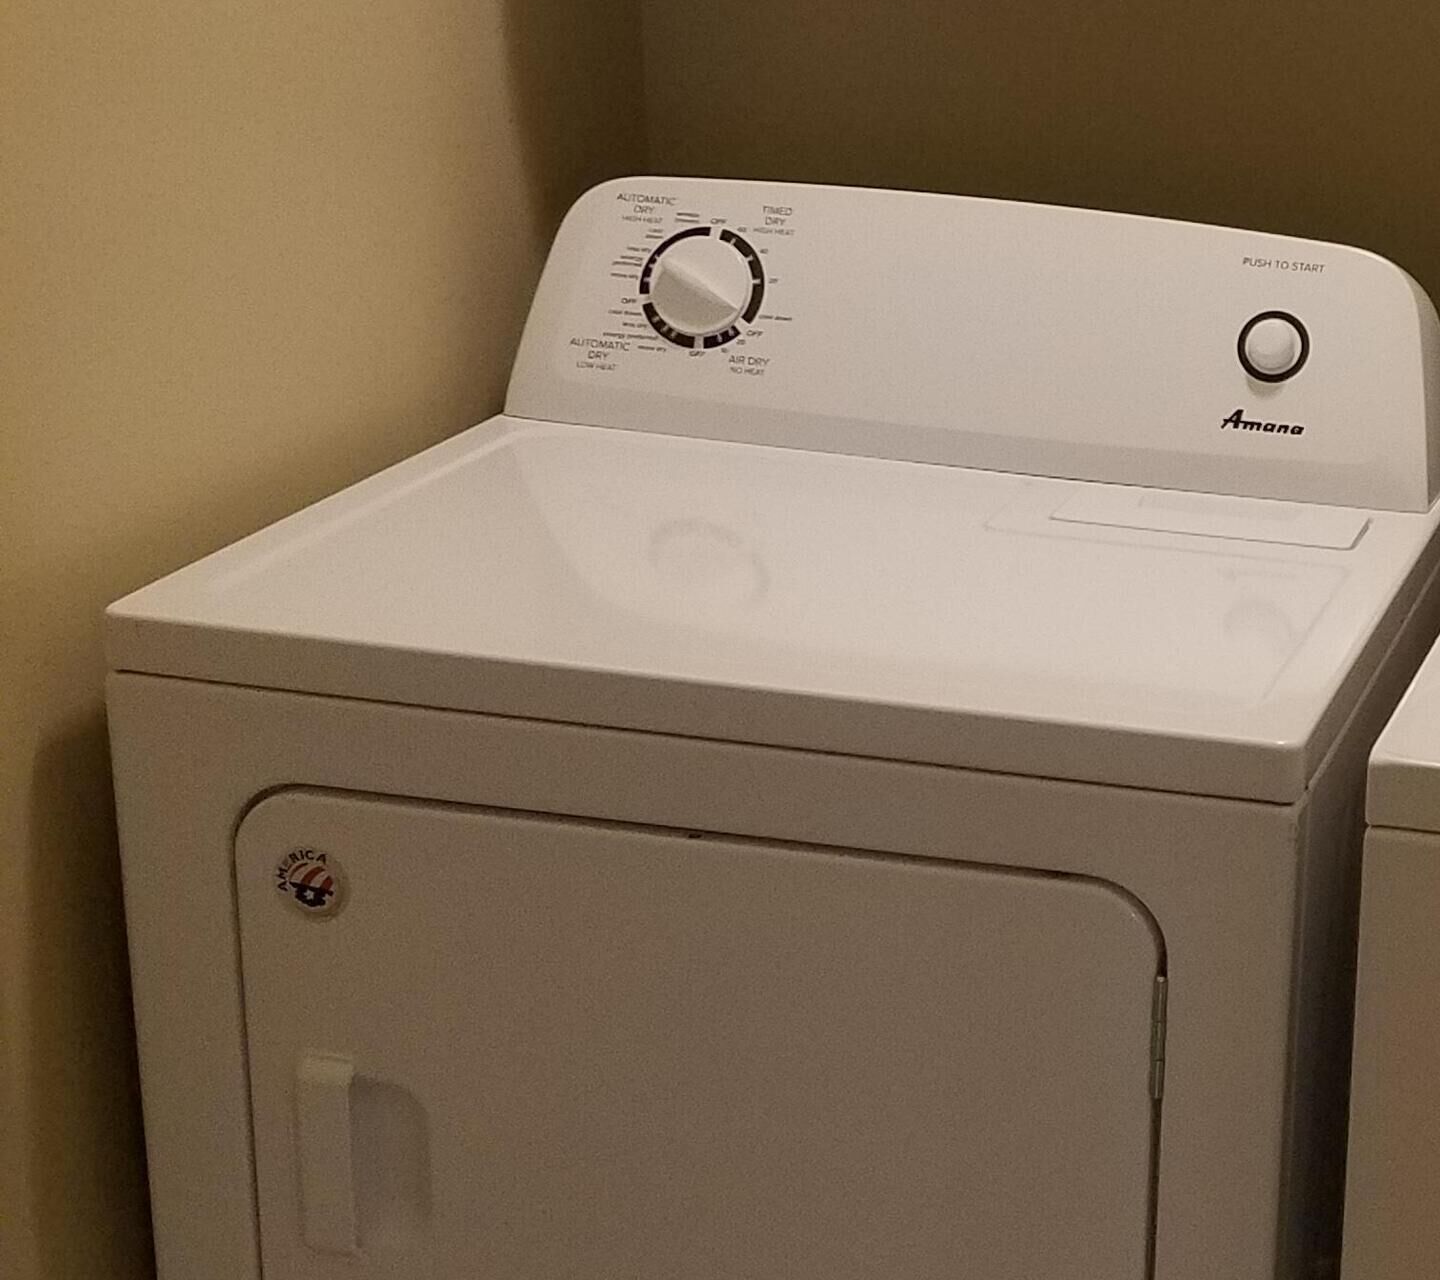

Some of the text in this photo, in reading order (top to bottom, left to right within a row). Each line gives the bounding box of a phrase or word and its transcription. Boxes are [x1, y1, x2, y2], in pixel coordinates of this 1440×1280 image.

[617, 192, 678, 206] AUTOMATIC
[634, 205, 655, 214] DRY
[762, 206, 793, 216] TIMED
[765, 216, 786, 226] DRY
[1242, 257, 1326, 274] PUSH TO START
[569, 337, 631, 352] AUTOMATIC
[588, 351, 609, 360] DRY
[728, 355, 770, 367] AIR DRY
[1220, 409, 1305, 437] Amana
